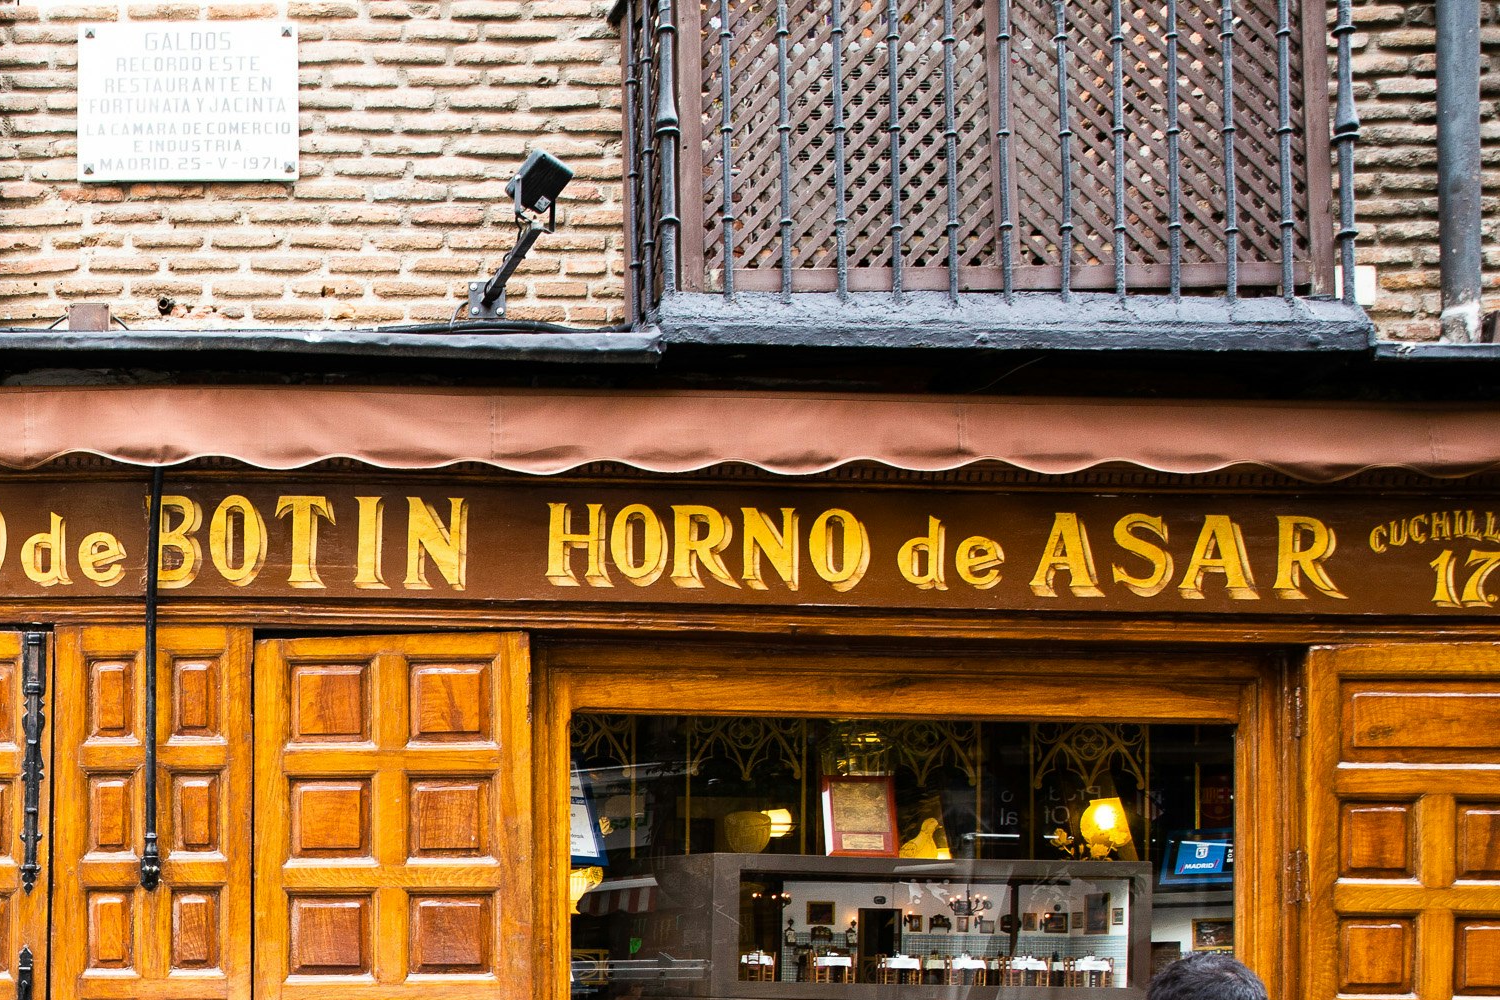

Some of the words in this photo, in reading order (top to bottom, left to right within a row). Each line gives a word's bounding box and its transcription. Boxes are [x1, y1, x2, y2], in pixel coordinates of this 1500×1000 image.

[144, 32, 231, 51] GALDOS
[209, 56, 260, 71] ESTE
[104, 77, 240, 93] RESTAURANTE
[248, 77, 272, 92] EN
[196, 97, 205, 112] Y
[86, 123, 106, 136] LA
[183, 122, 201, 135] DE
[207, 122, 291, 135] COMERCIO
[134, 140, 143, 152] E
[20, 512, 128, 587] de
[147, 494, 469, 592] BOTIN
[545, 502, 871, 592] HORNO
[897, 515, 1006, 590] de
[1029, 512, 1348, 600] ASAR
